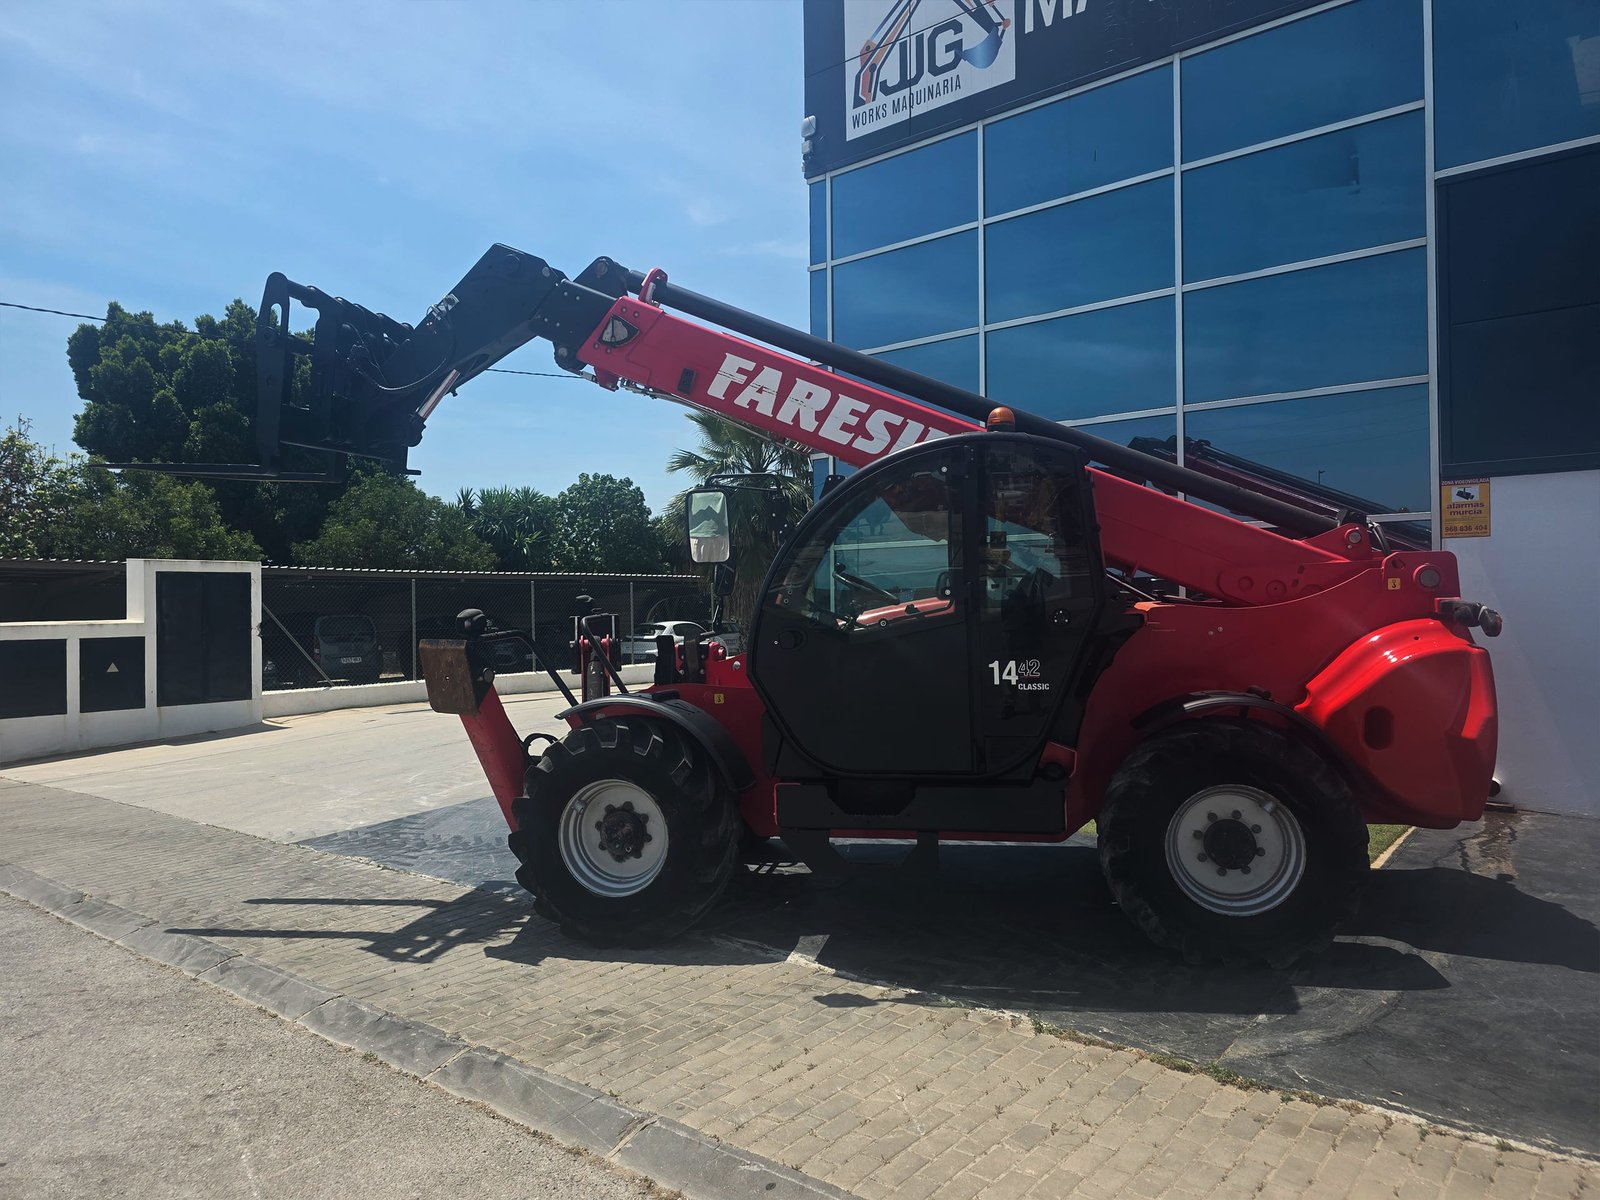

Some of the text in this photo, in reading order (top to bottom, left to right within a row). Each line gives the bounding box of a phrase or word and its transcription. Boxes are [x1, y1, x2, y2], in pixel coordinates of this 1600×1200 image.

[879, 19, 964, 97] JUG
[852, 74, 962, 130] WORKS MAQUINARIA
[1446, 502, 1485, 510] alarmas
